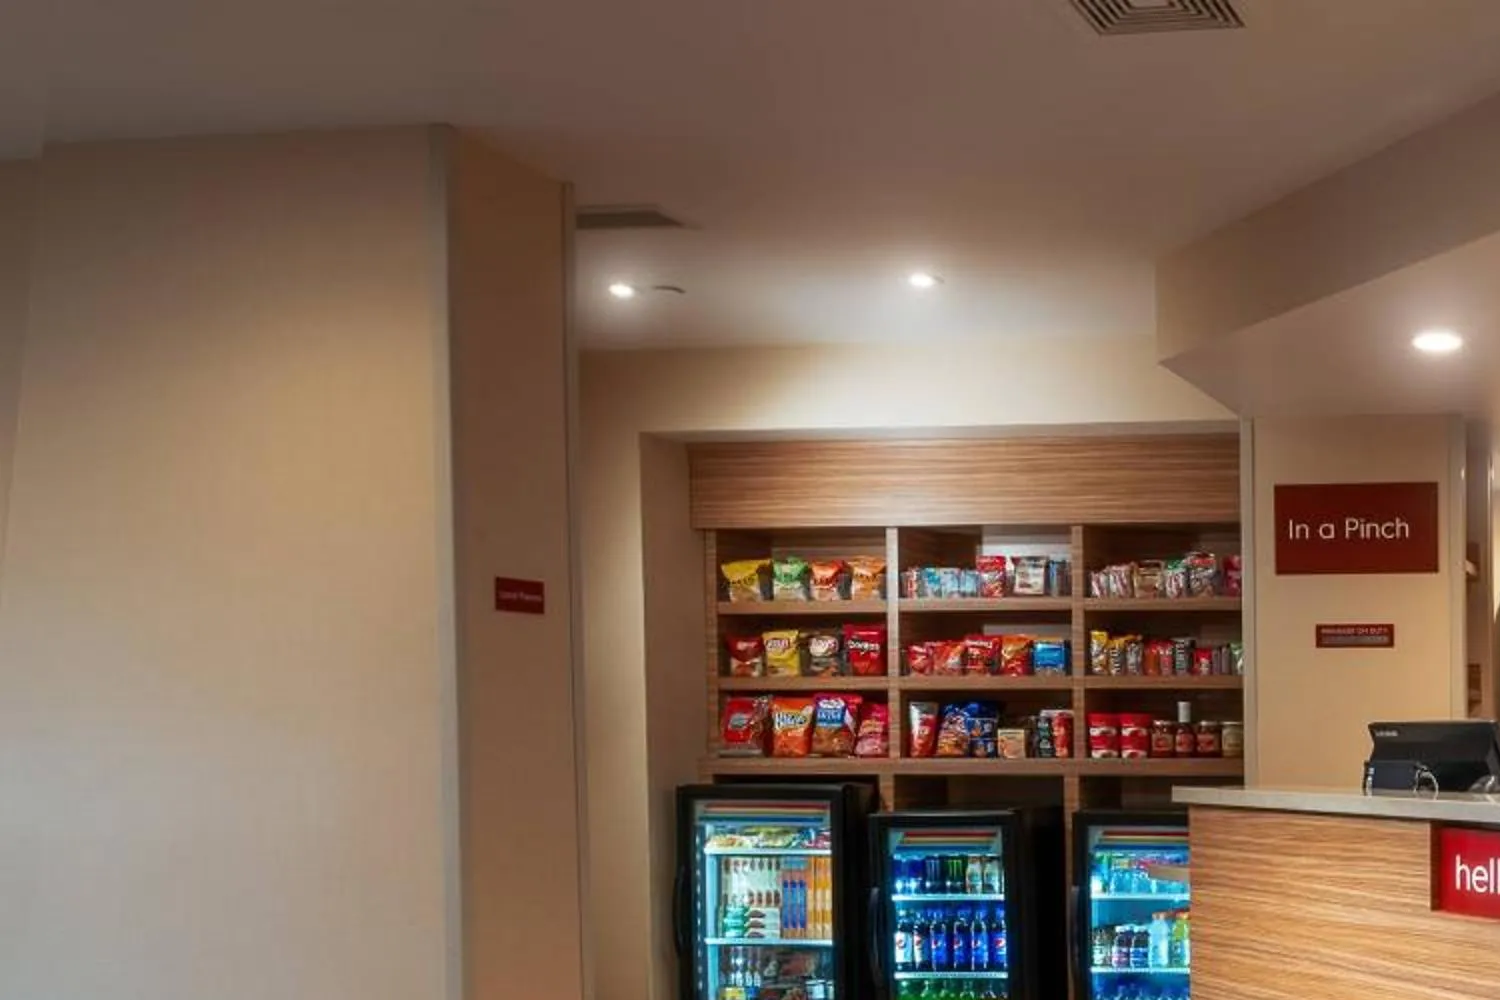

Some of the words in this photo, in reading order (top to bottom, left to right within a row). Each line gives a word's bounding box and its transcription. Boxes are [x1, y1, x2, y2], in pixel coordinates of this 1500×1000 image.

[1289, 519, 1309, 540] In
[1319, 523, 1335, 539] a
[1345, 517, 1409, 539] Pinch
